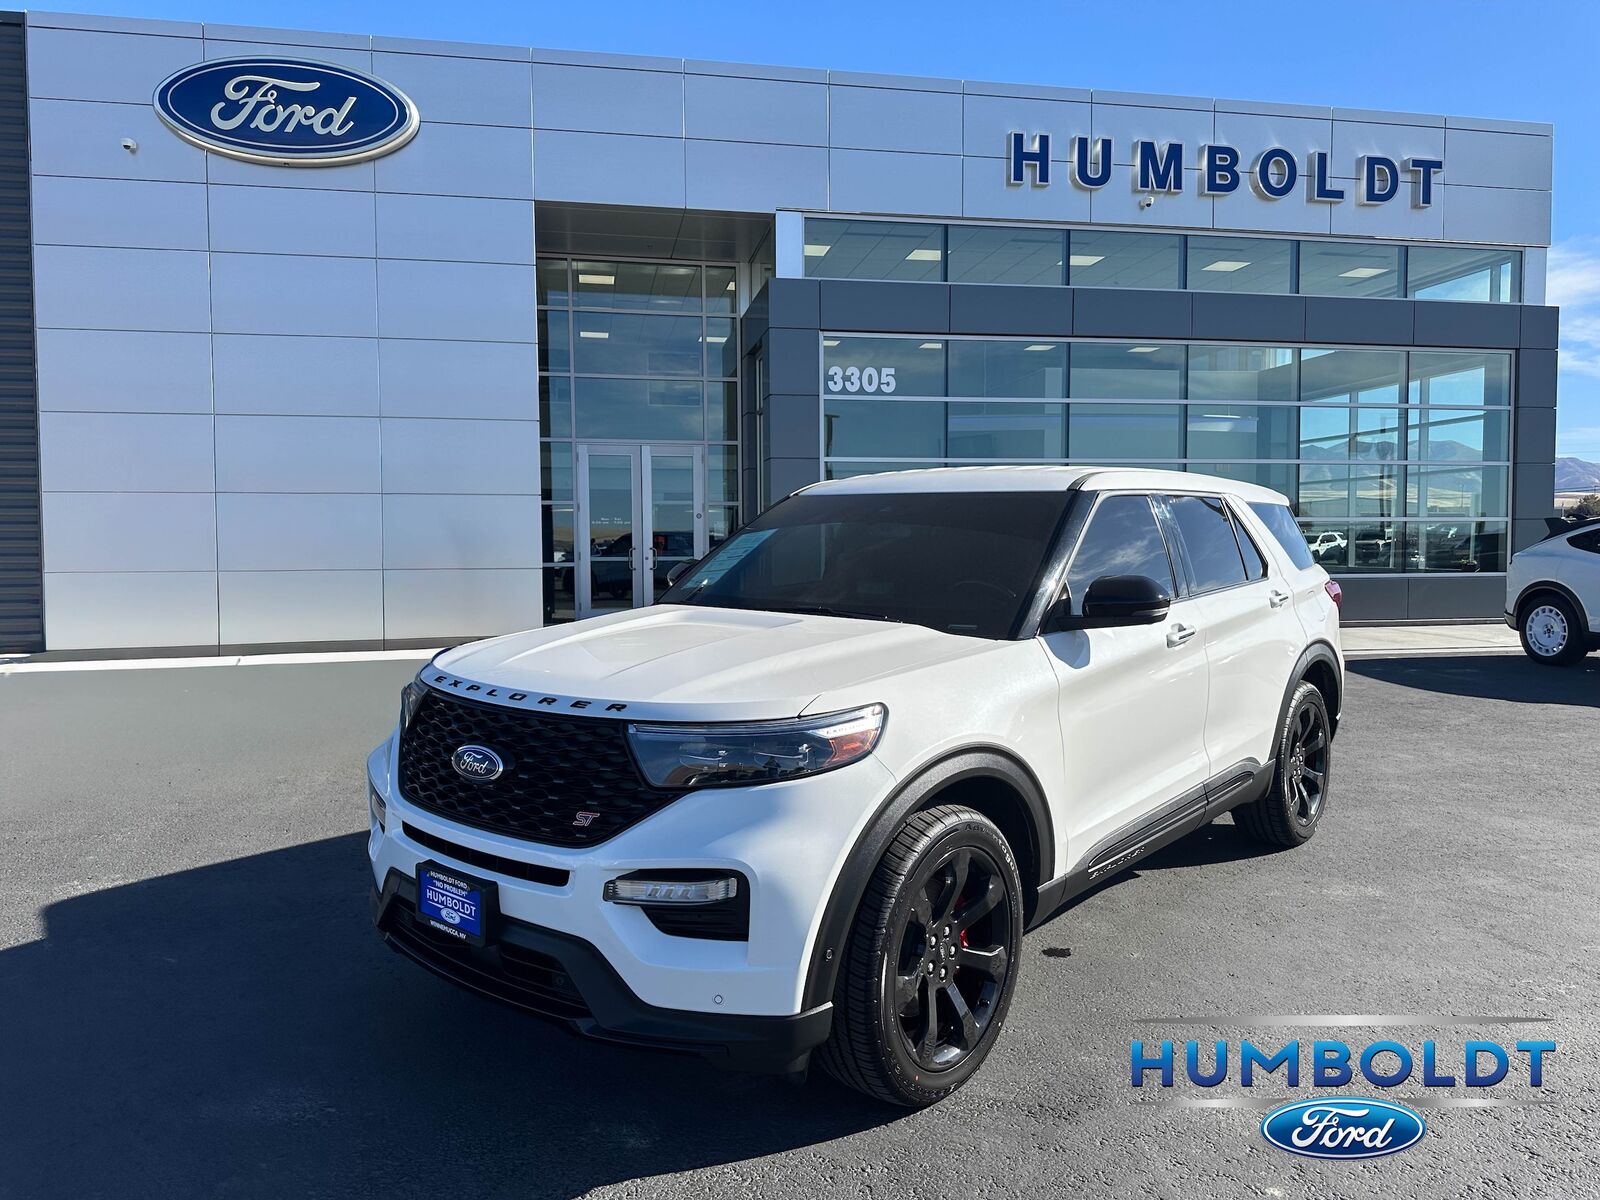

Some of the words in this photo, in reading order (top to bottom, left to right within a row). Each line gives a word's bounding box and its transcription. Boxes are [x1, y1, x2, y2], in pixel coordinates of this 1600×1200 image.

[211, 75, 357, 136] Ford
[1009, 131, 1444, 208] HUMBOLDT
[828, 366, 896, 393] 3305
[433, 675, 628, 712] EXPLORER
[459, 751, 489, 775] Ford
[573, 811, 600, 826] ST
[430, 871, 455, 884] HUMBOLDT
[454, 878, 468, 889] FORD
[426, 889, 476, 916] HUMBOLDT
